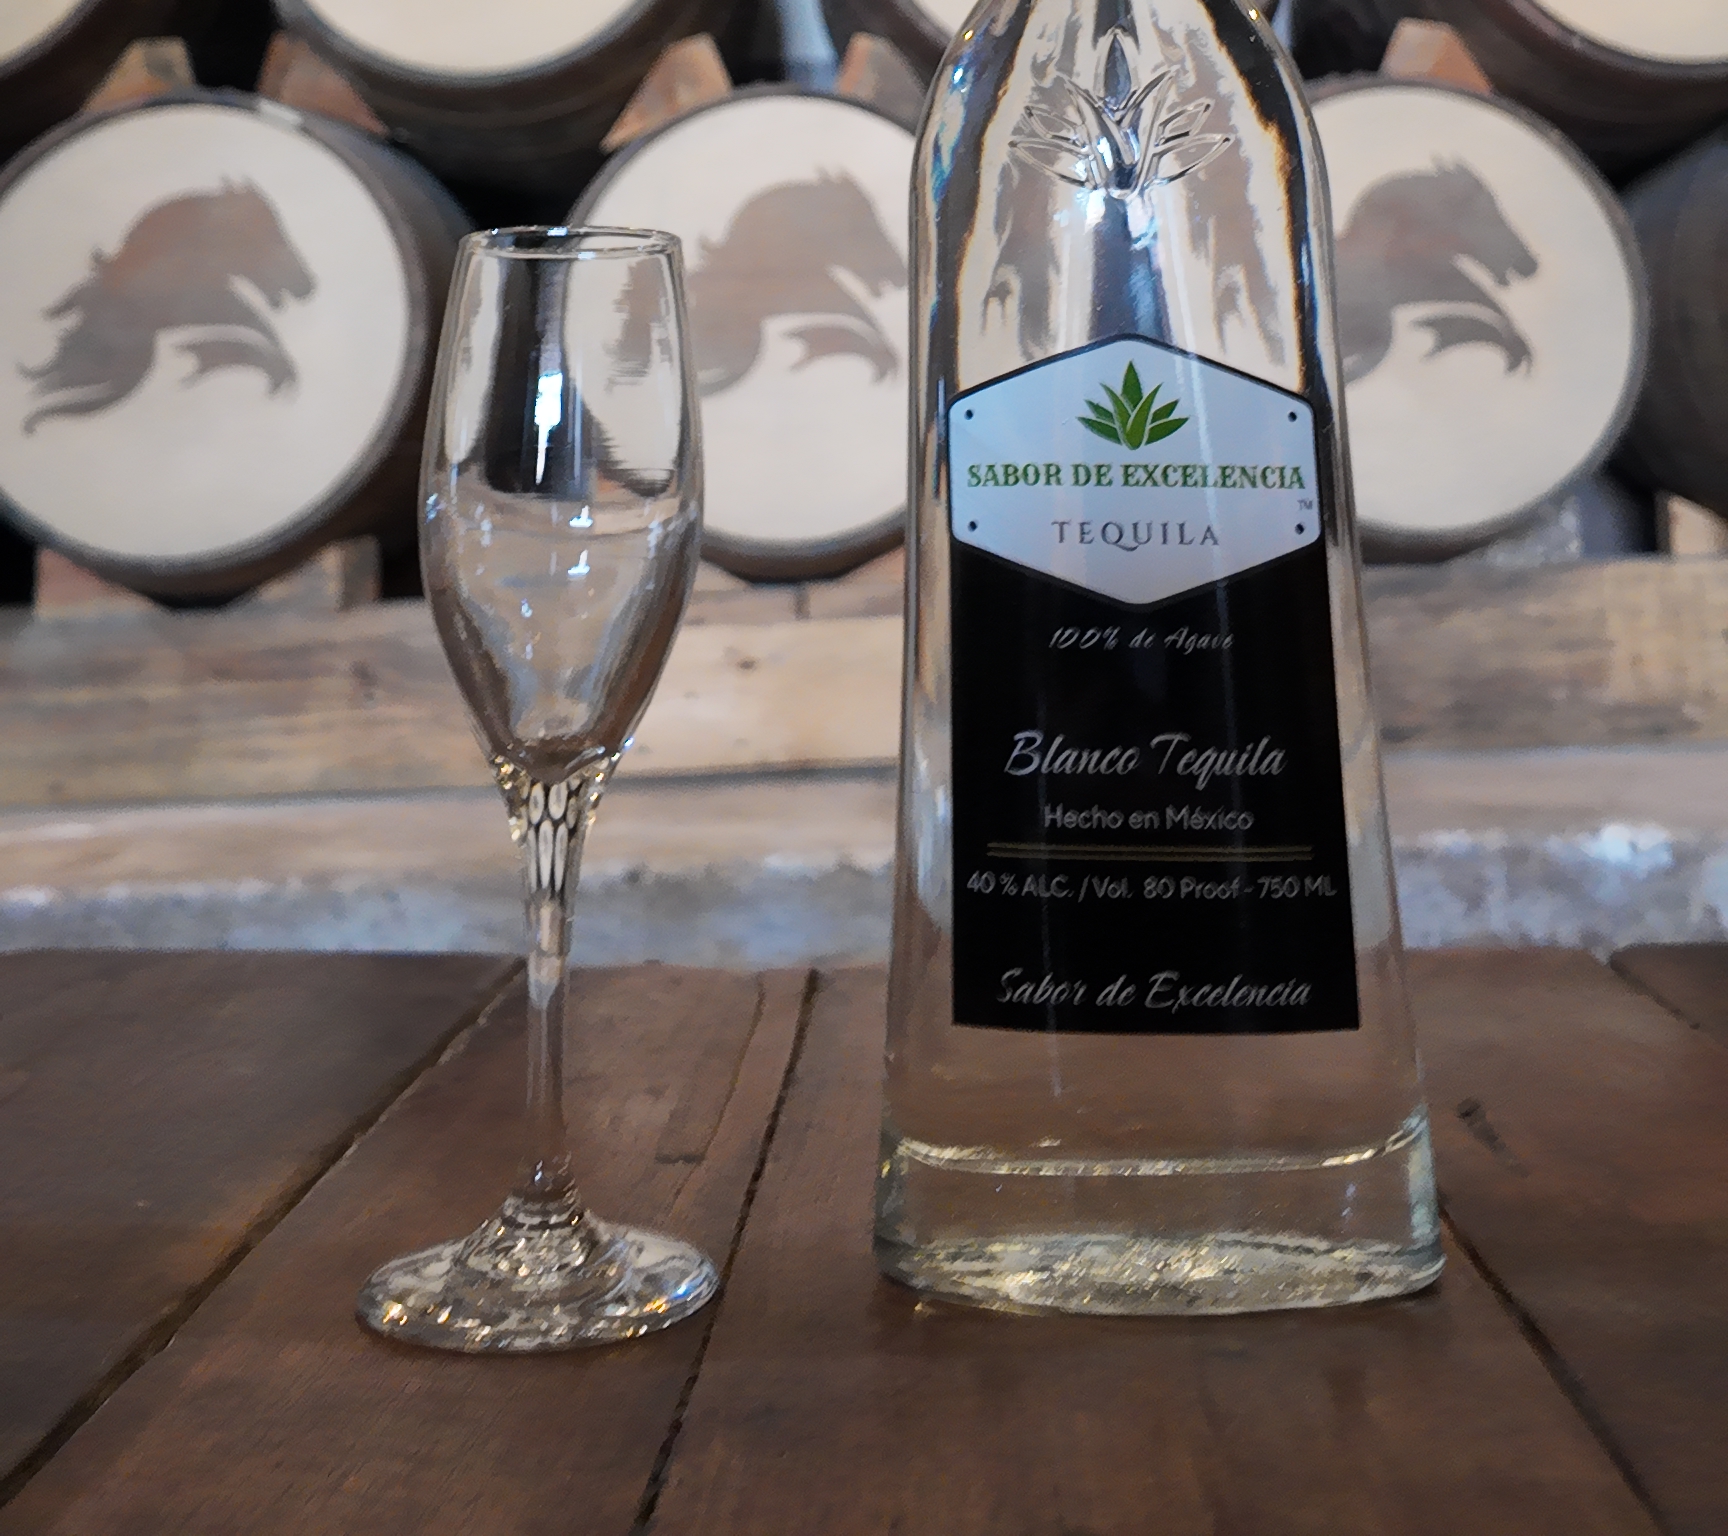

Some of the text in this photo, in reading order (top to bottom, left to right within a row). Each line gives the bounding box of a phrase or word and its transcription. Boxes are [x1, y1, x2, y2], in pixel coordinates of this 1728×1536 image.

[967, 463, 1306, 490] SABOR DE EXCELENCIA
[1051, 520, 1220, 552] TEQUILA
[1049, 625, 1235, 656] 100% de Agave
[1004, 729, 1287, 791] Blanco Tequila
[1044, 803, 1255, 831] Hecho en México
[1143, 875, 1176, 899] 80
[1303, 874, 1338, 898] ML
[997, 967, 1312, 1015] Sabor de Excelencia
